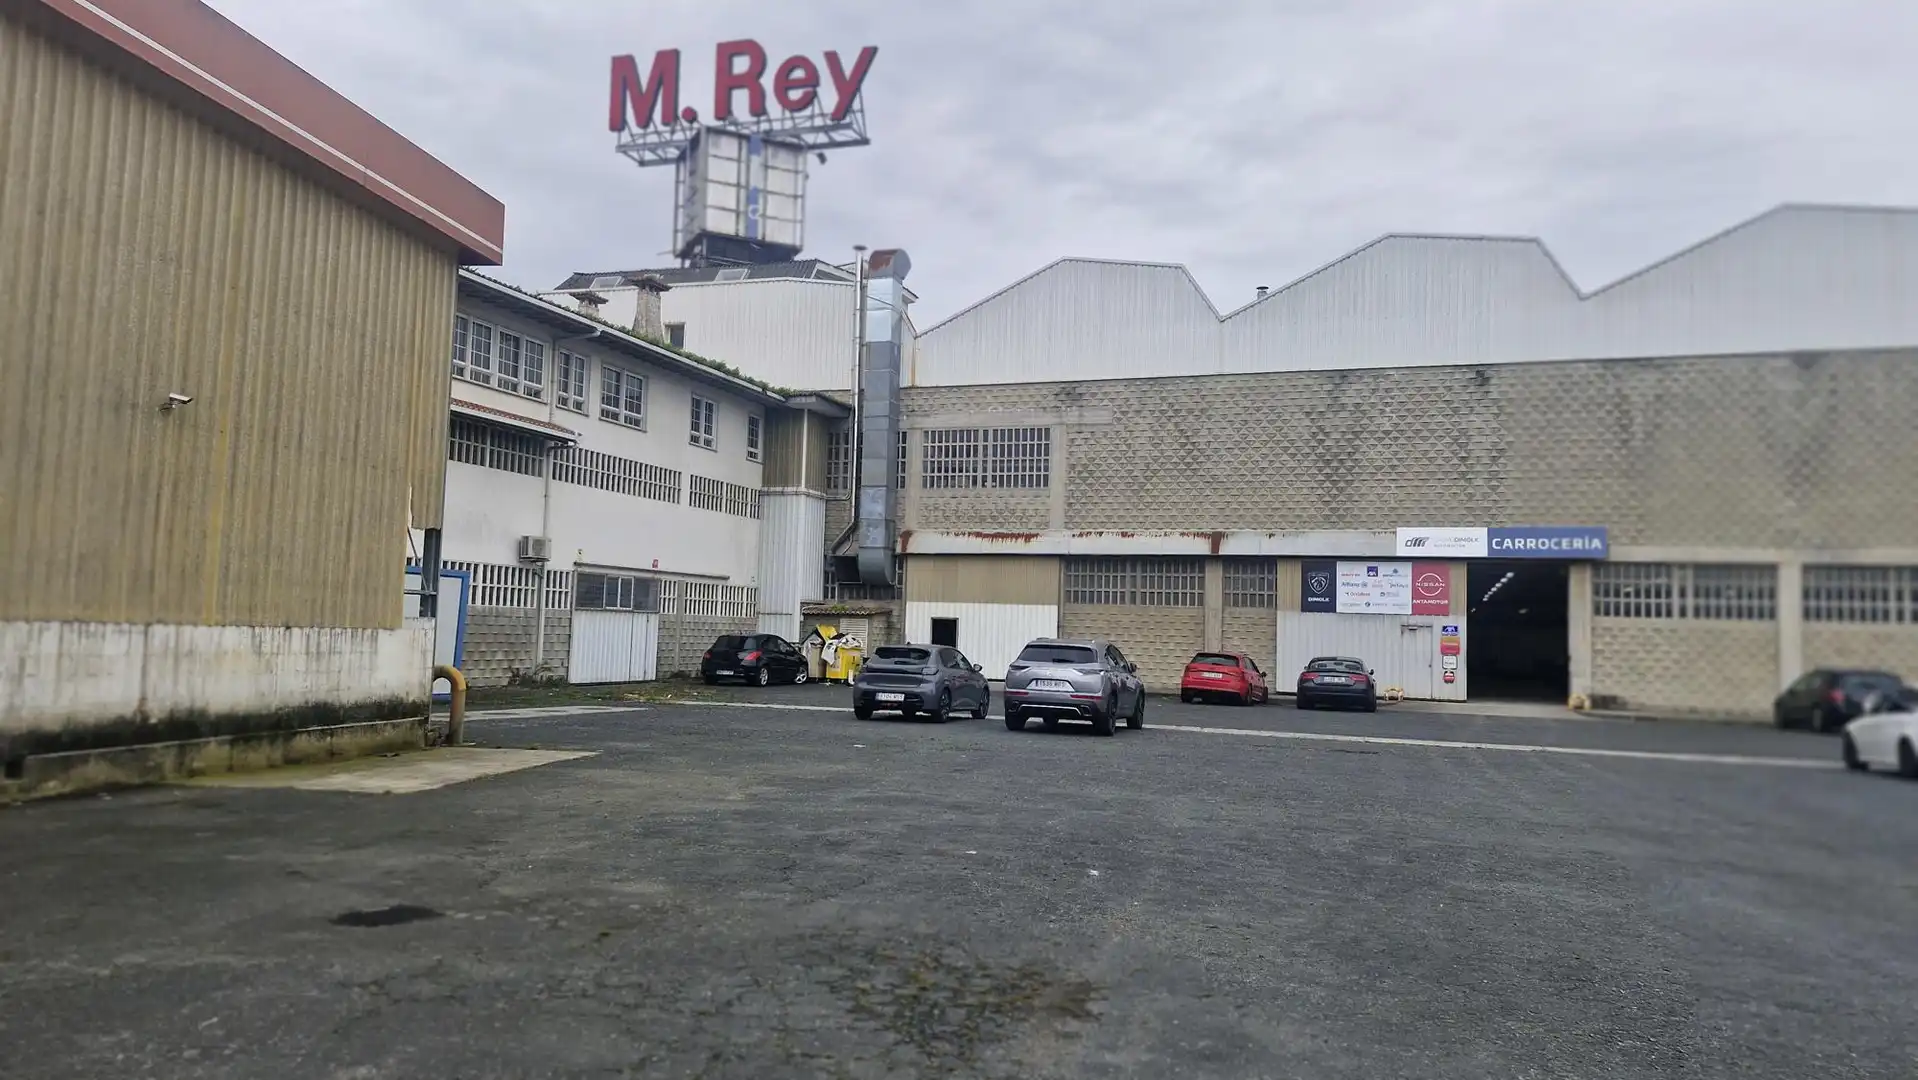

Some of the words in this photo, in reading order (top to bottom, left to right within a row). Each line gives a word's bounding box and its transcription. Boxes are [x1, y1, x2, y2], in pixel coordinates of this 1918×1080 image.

[609, 48, 698, 131] M.
[714, 39, 878, 121] Rey
[1492, 535, 1602, 550] CARROCERÍA
